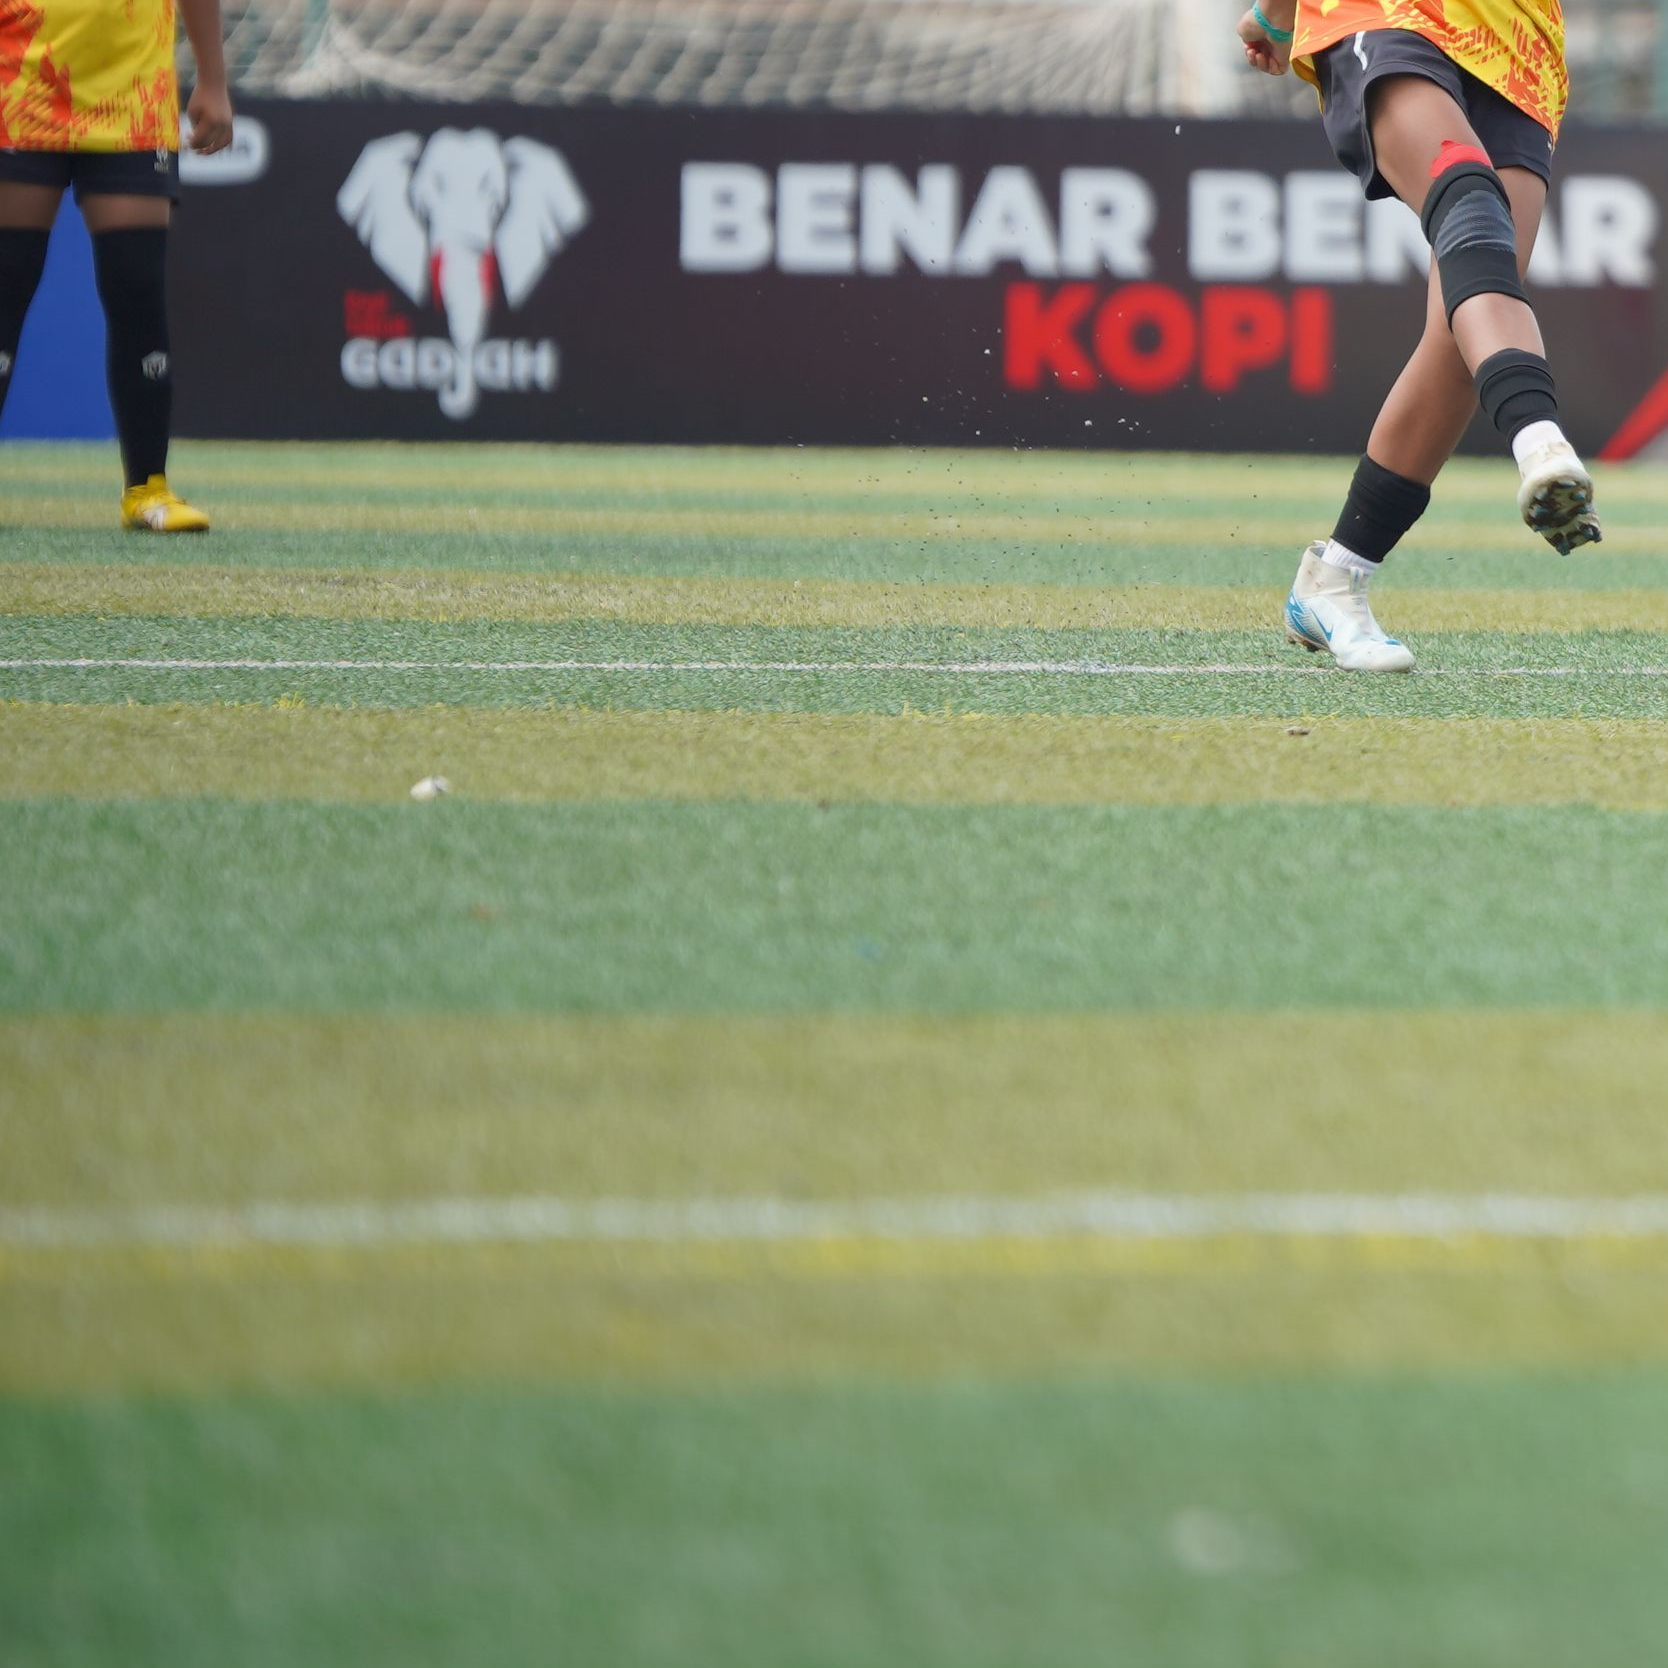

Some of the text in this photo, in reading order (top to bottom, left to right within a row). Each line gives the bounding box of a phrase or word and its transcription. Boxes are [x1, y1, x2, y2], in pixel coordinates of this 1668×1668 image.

[680, 161, 1660, 289] BENAR BENR
[1002, 281, 1334, 396] KOPI
